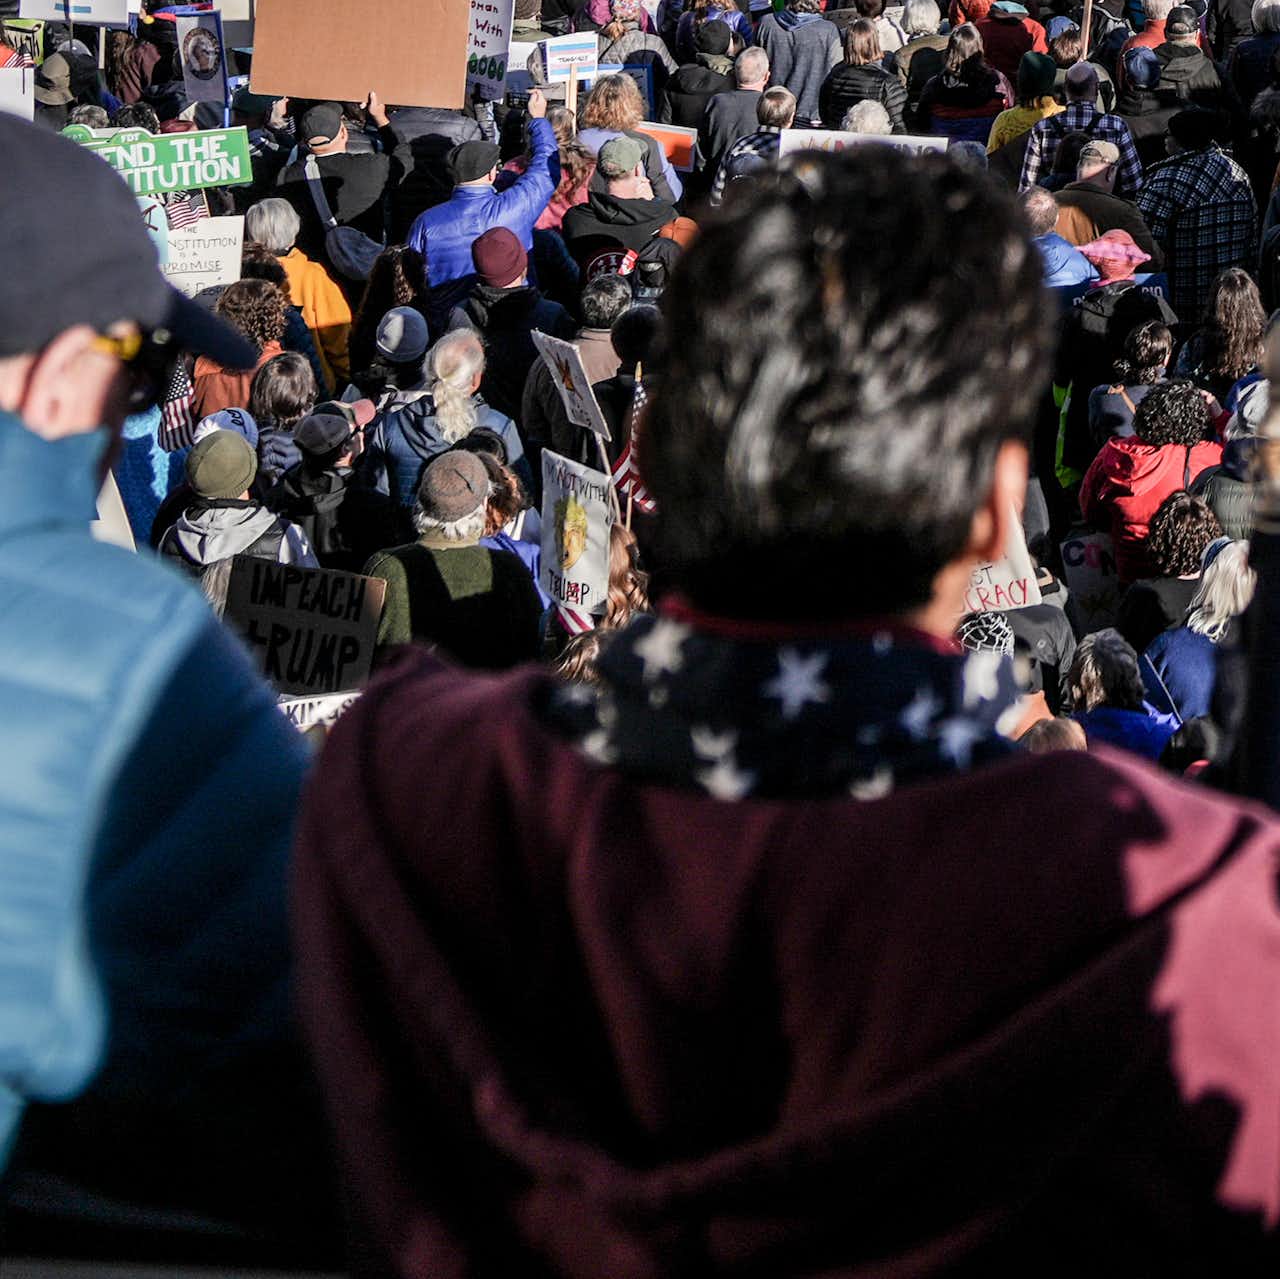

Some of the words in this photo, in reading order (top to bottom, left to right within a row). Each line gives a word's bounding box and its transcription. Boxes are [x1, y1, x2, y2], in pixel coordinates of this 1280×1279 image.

[475, 18, 504, 38] With
[174, 132, 228, 160] THE
[183, 226, 198, 234] THE
[249, 565, 368, 621] IMPEACH
[249, 622, 361, 691] TRUMP
